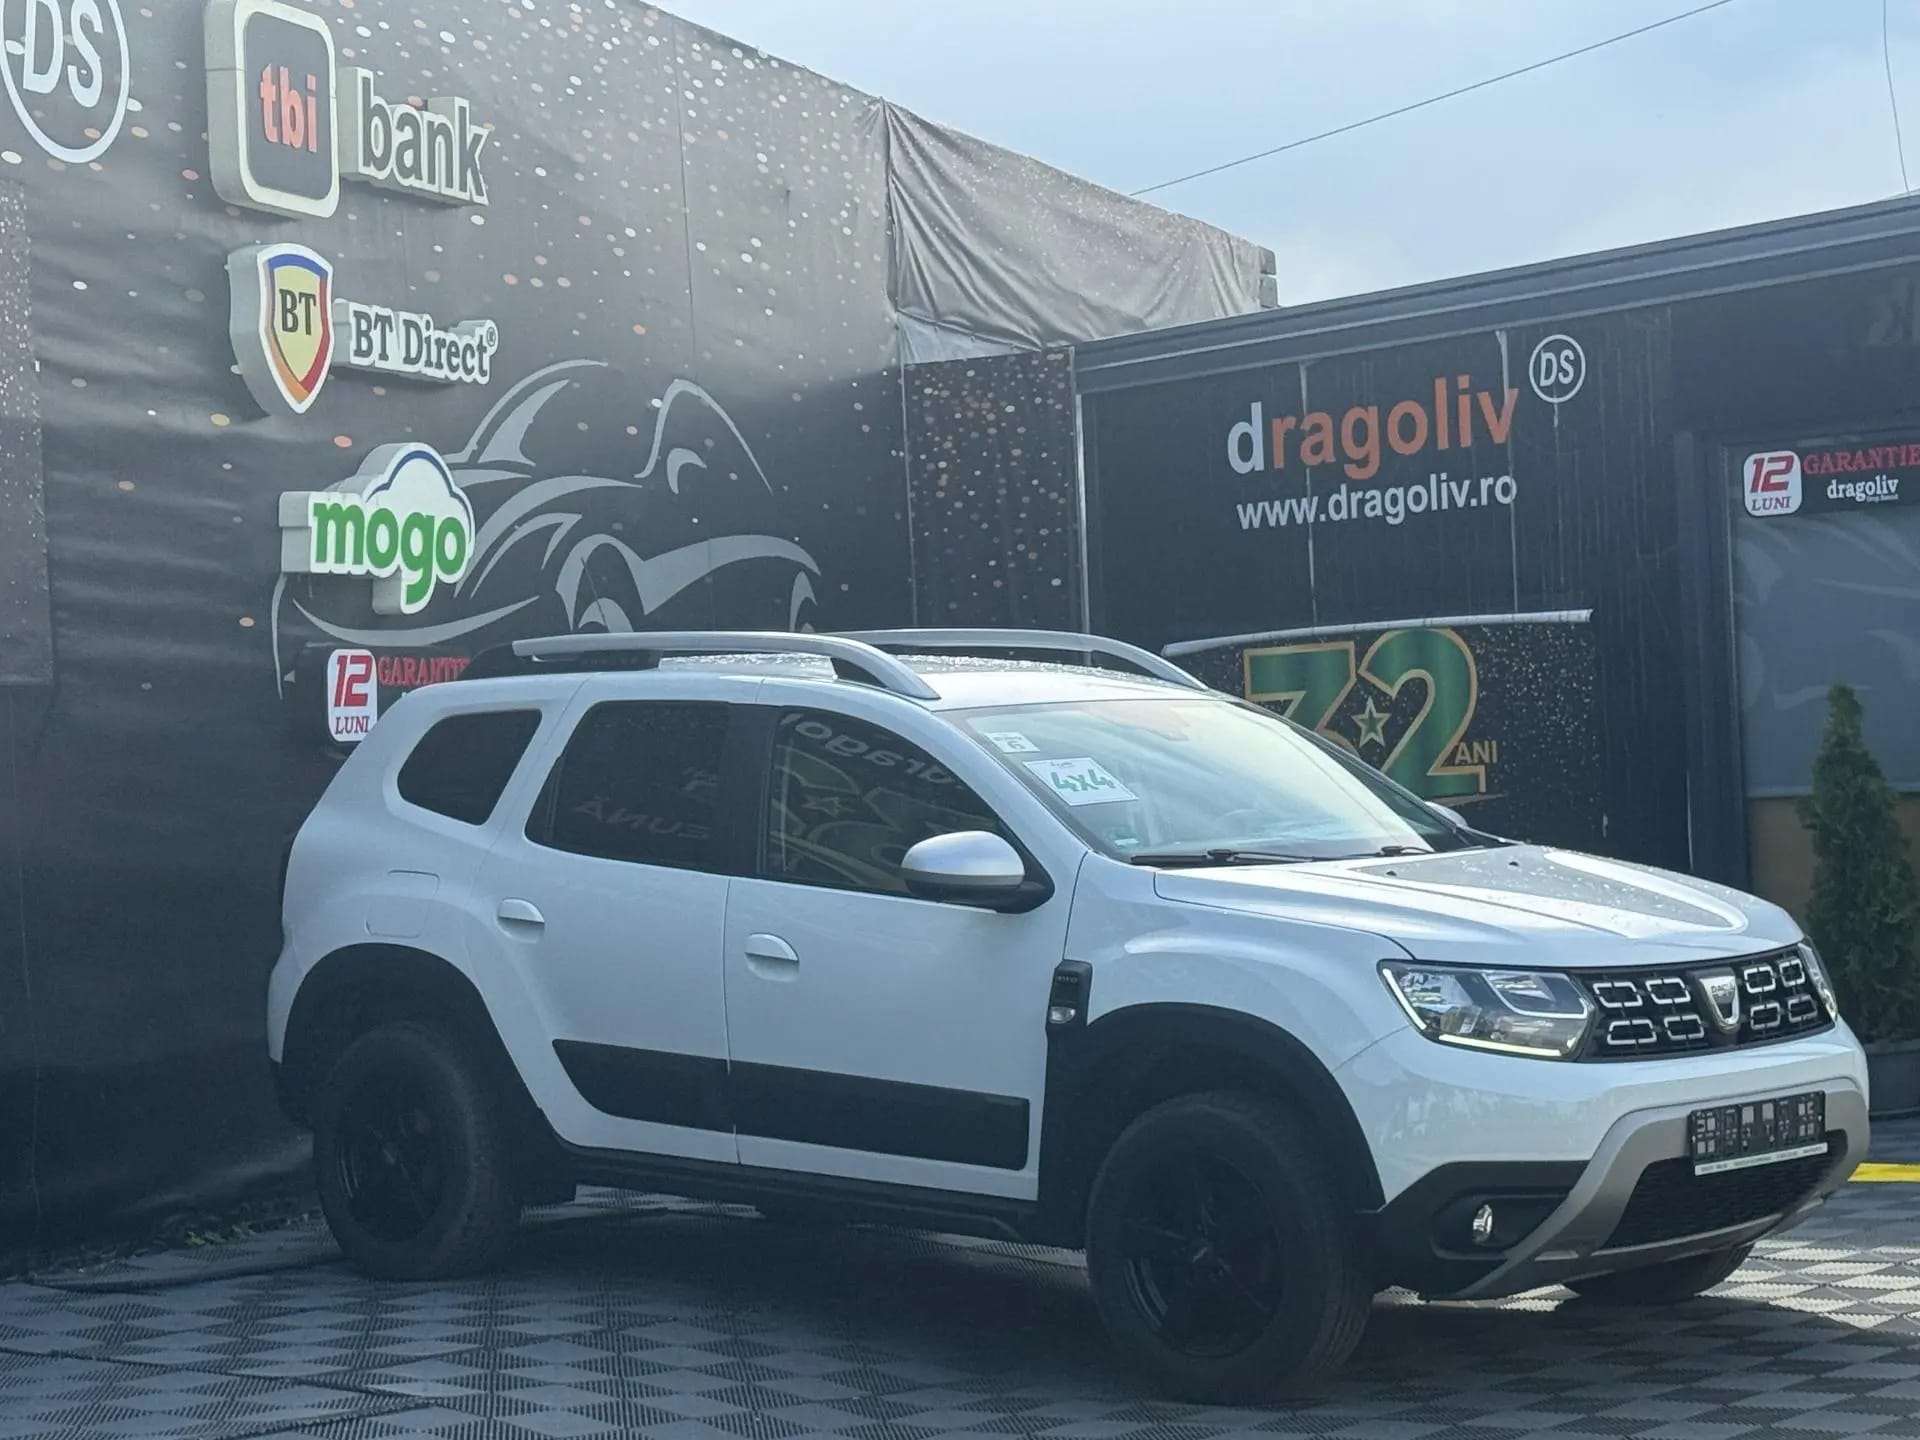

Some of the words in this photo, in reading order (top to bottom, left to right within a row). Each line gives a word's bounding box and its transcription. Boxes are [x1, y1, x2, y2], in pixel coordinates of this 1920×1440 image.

[23, 0, 103, 107] DS
[259, 63, 318, 154] tbi
[359, 74, 488, 202] bank
[279, 288, 317, 336] BT
[352, 310, 394, 362] BT
[1539, 349, 1575, 387] DS
[1227, 374, 1519, 480] dragoliv
[1750, 455, 1795, 494] 12
[1802, 443, 1920, 476] GARANTIE
[1236, 473, 1518, 530] www.dragoliv.ro
[1751, 497, 1792, 512] LUNI
[1826, 474, 1899, 502] dragoliv
[312, 501, 467, 606] mogo
[333, 655, 374, 708] 12
[334, 715, 370, 735] LUNI
[1454, 740, 1498, 766] ANI
